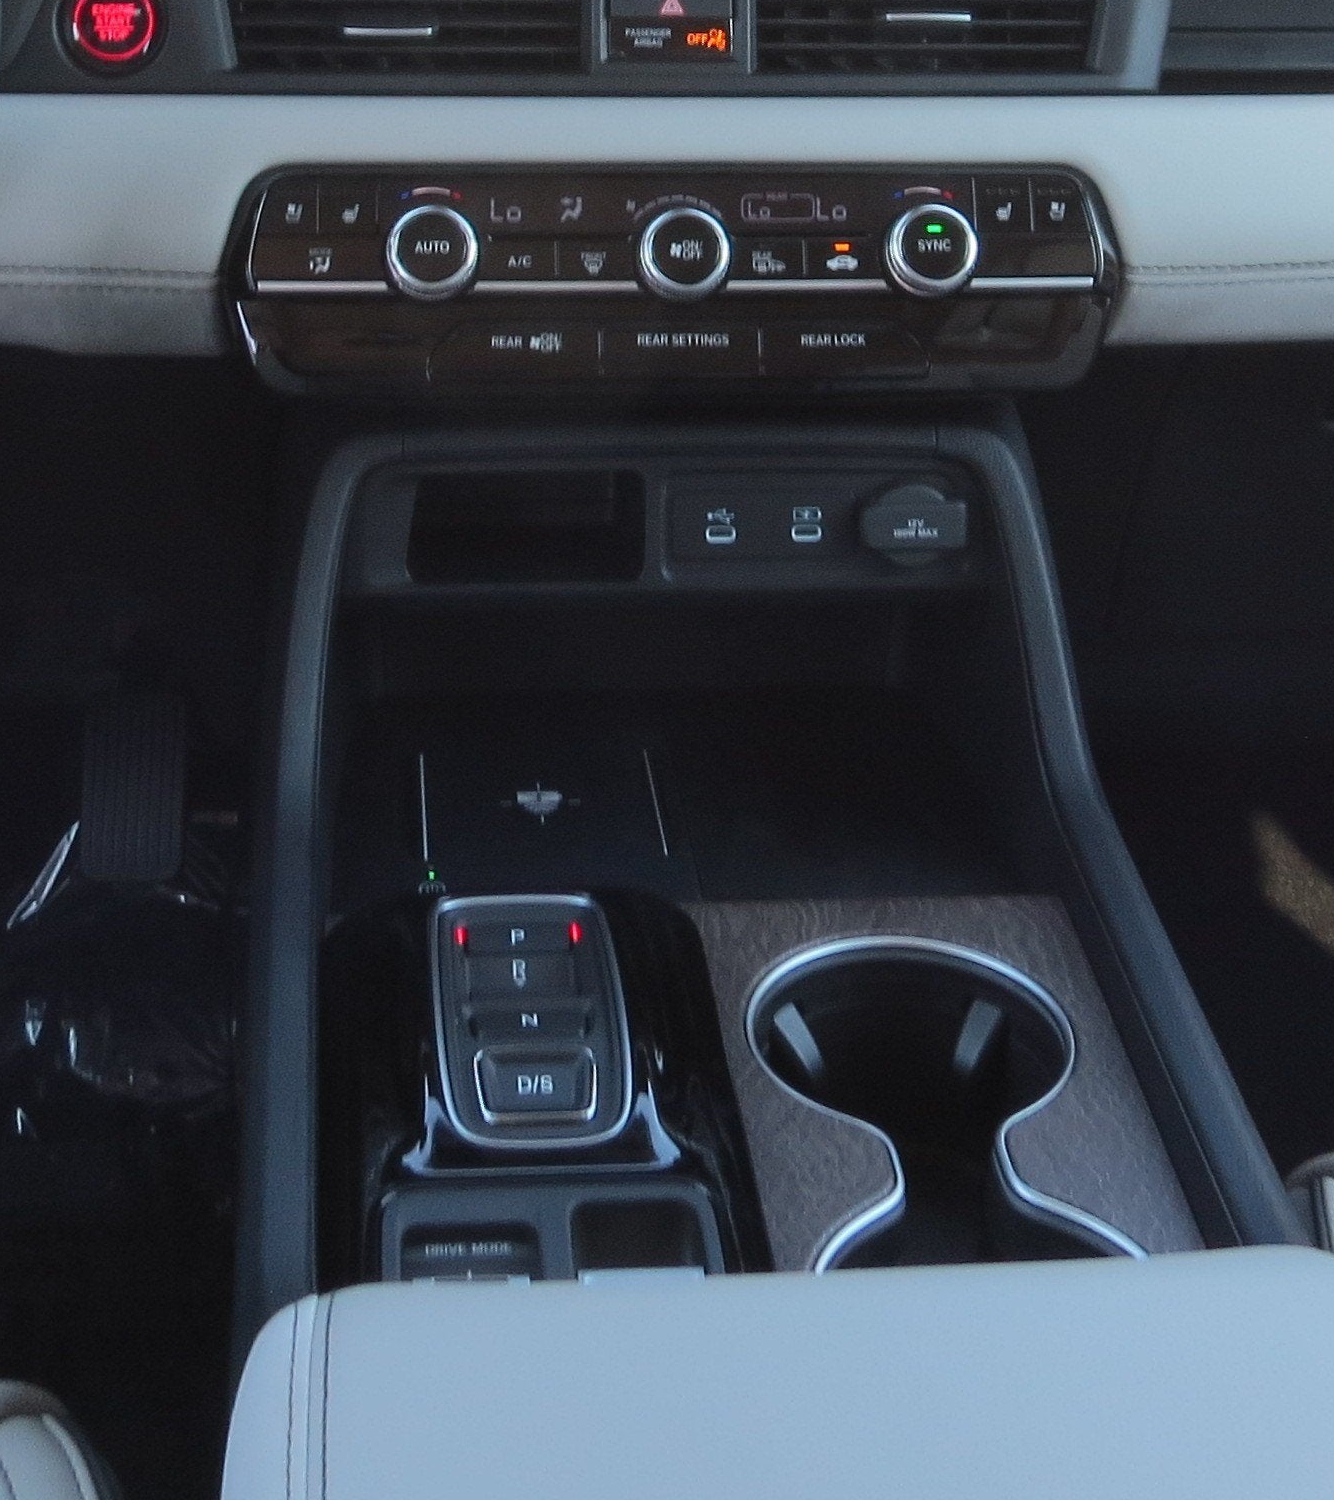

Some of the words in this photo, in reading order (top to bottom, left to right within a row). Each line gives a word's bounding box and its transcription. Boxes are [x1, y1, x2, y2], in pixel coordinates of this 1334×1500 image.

[92, 3, 135, 16] ENGINE
[95, 15, 131, 26] START
[98, 29, 130, 42] STOP
[625, 26, 672, 39] PASSENGER
[687, 33, 708, 46] OFF
[414, 240, 450, 254] AUTO
[917, 238, 951, 253] SYNC
[508, 255, 532, 269] A/C
[491, 335, 522, 349] REAR
[637, 333, 668, 347] REAR
[671, 333, 730, 348] SETTINGS
[800, 333, 831, 347] REAR
[834, 333, 866, 347] LOCK
[917, 528, 938, 538] MAX
[511, 927, 525, 946] P
[521, 1013, 539, 1028] N
[425, 1243, 466, 1257] DRIVE
[471, 1241, 512, 1256] MODE
